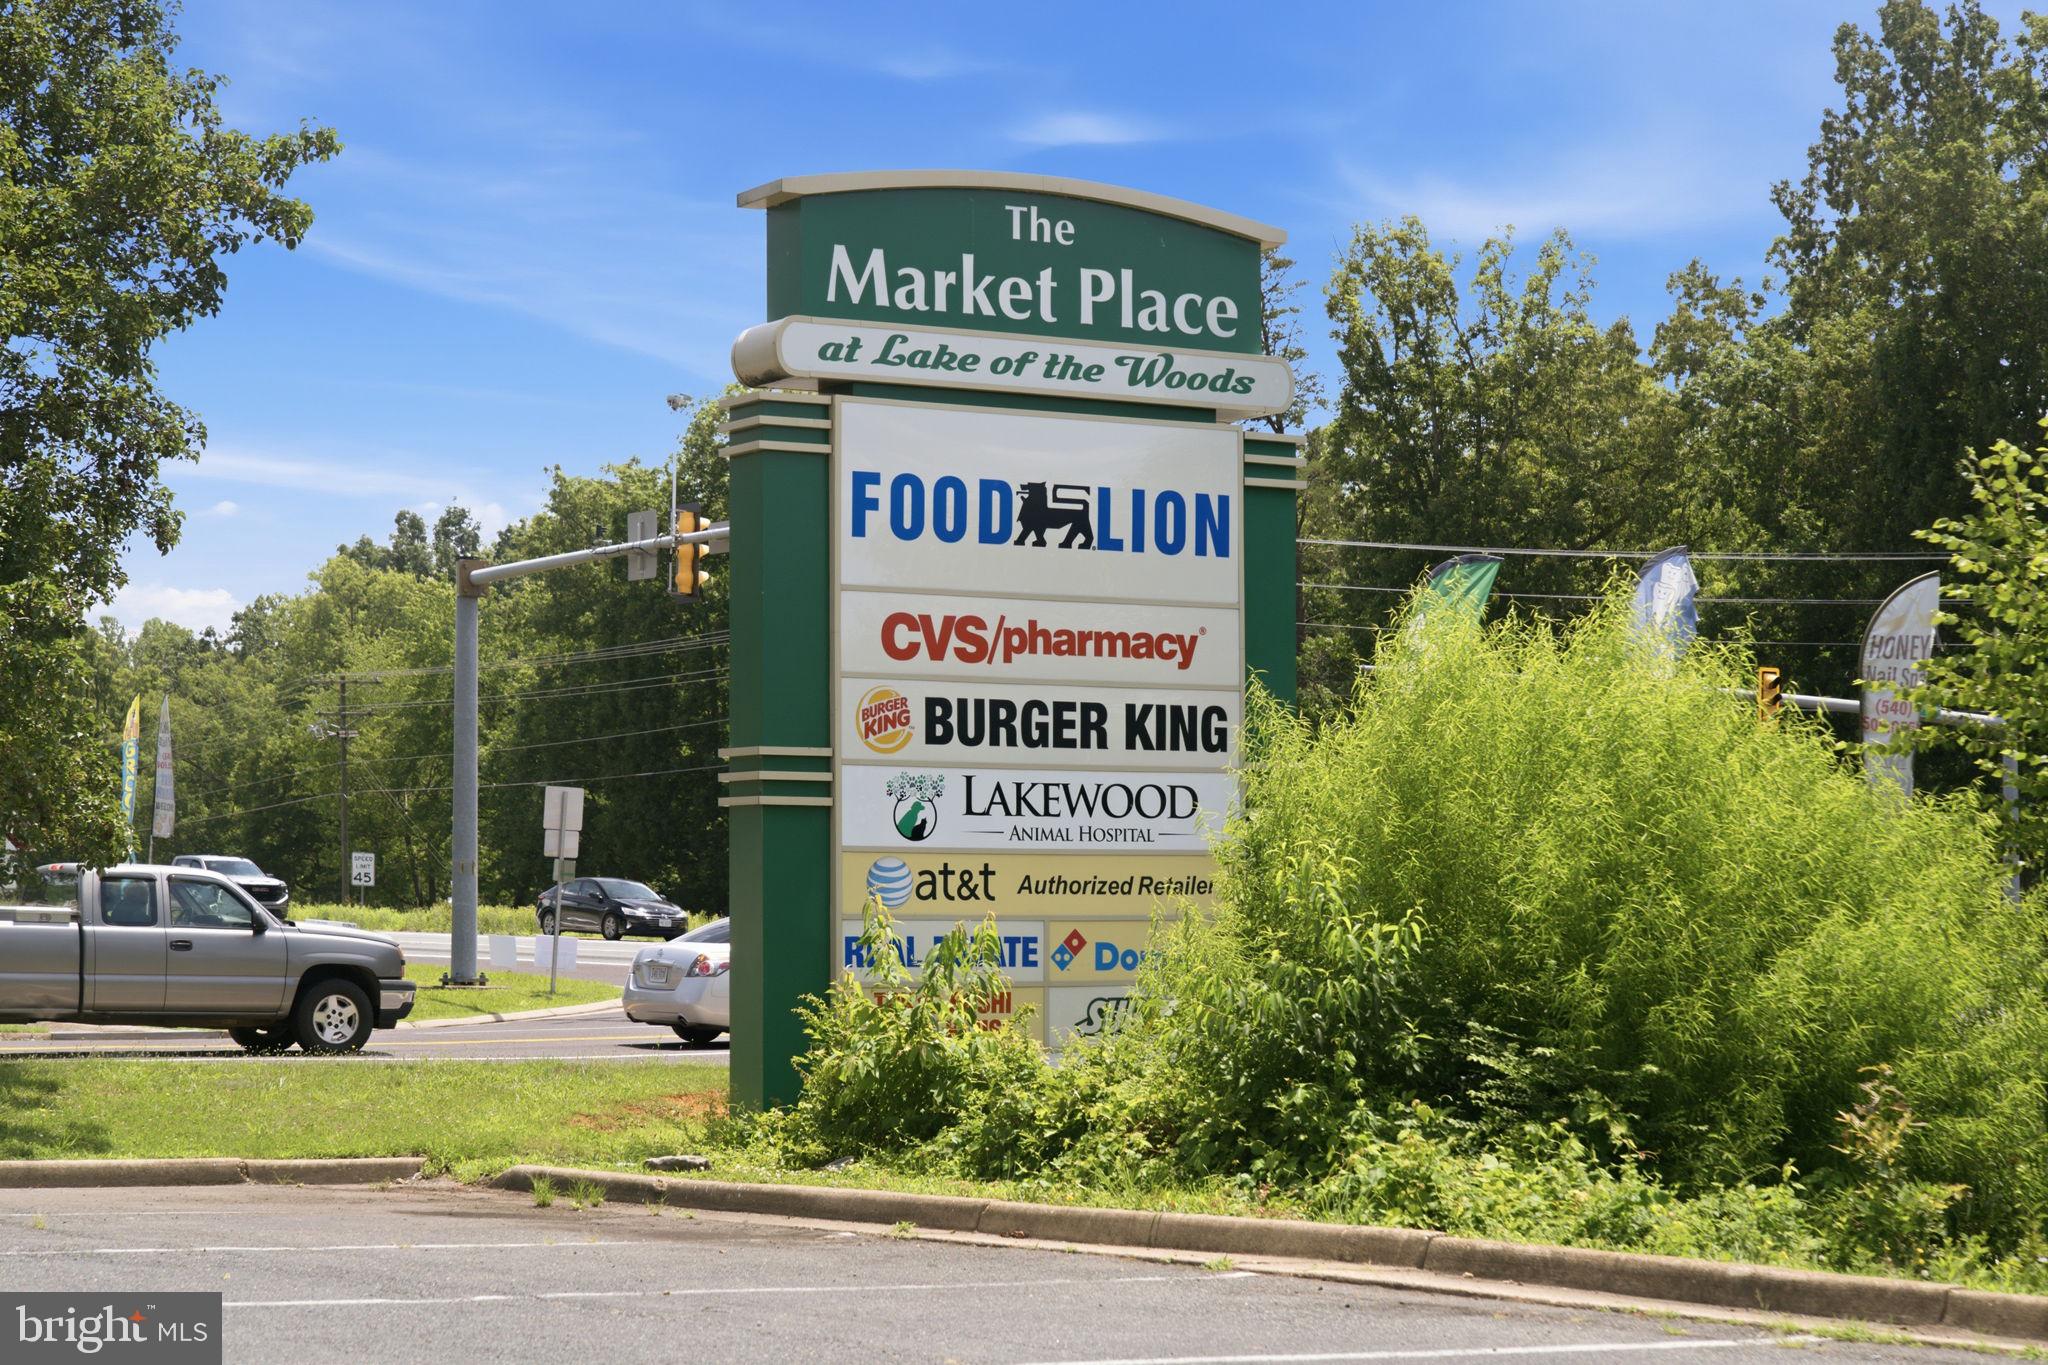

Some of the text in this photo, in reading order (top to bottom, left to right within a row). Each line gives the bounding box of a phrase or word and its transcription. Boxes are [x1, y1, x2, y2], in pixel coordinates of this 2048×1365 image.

[1005, 204, 1075, 246] The
[826, 243, 1239, 339] Market Place
[818, 333, 1256, 395] at Lake of the Woods
[851, 470, 1230, 559] FOOD LION
[1869, 635, 1932, 660] HONEY
[861, 696, 909, 722] BURGER
[864, 708, 911, 740] KING
[924, 696, 1228, 754] BURGER KING
[962, 774, 1198, 820] LAKEWOOD
[1009, 824, 1155, 843] ANIMAL HOSPITAL
[354, 872, 371, 882] 45
[915, 861, 997, 902] at&t
[1016, 874, 1133, 896] Authorized
